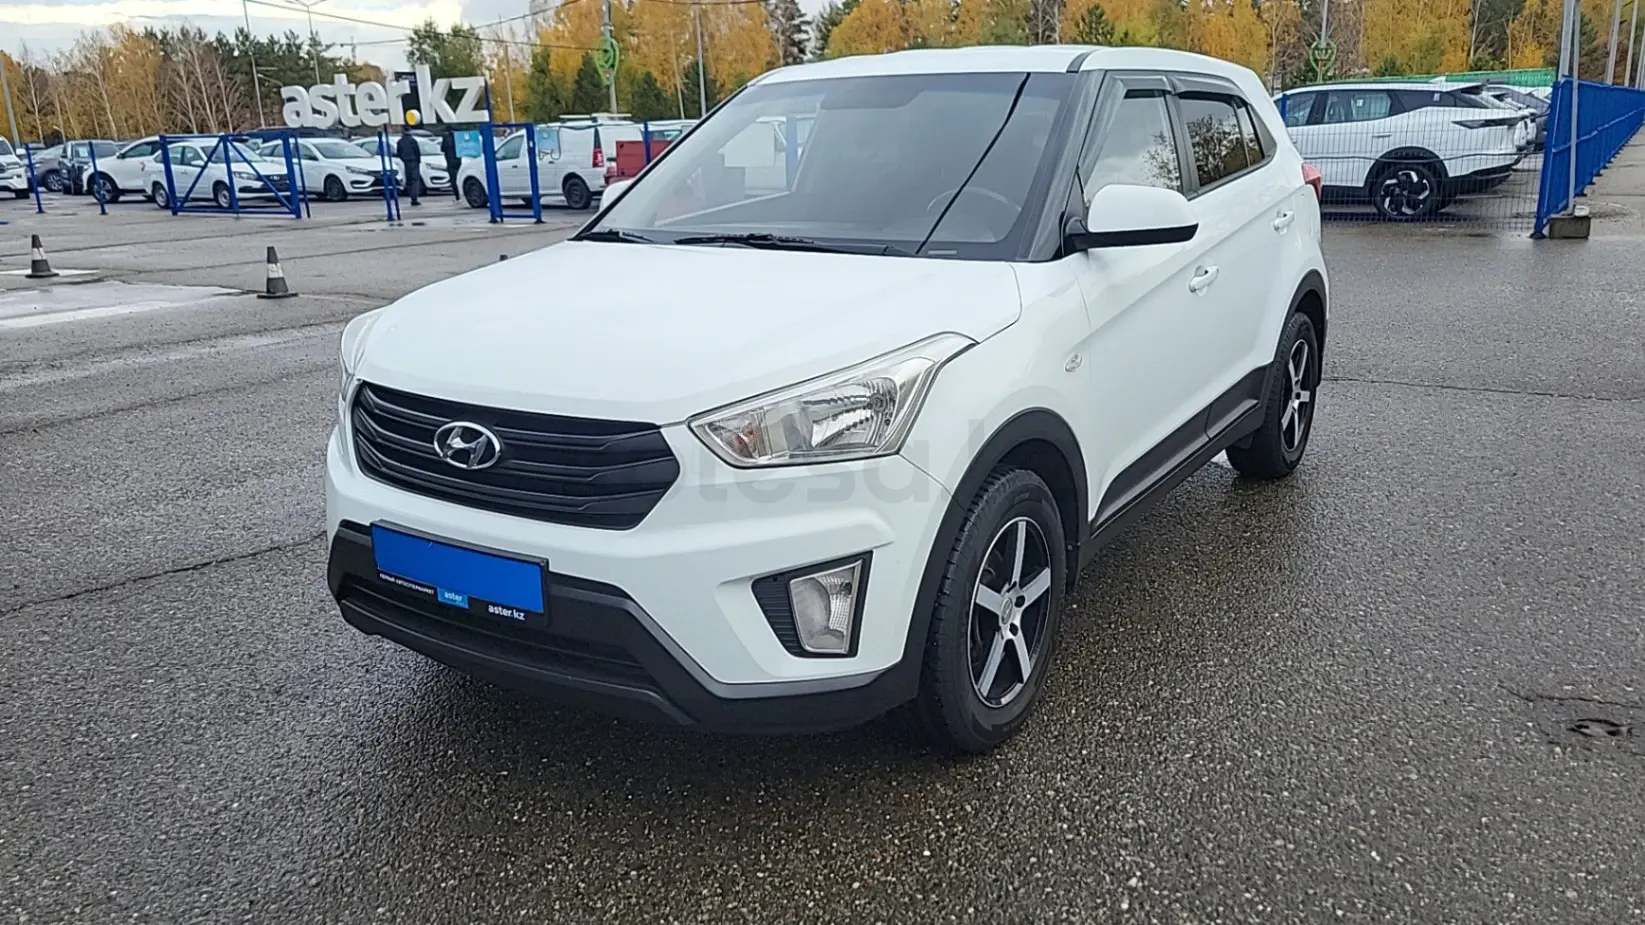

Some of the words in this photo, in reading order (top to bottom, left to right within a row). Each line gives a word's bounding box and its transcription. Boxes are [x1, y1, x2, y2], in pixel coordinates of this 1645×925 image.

[281, 64, 490, 128] aster.kz
[444, 591, 463, 602] aster
[488, 604, 526, 621] aster.kz
